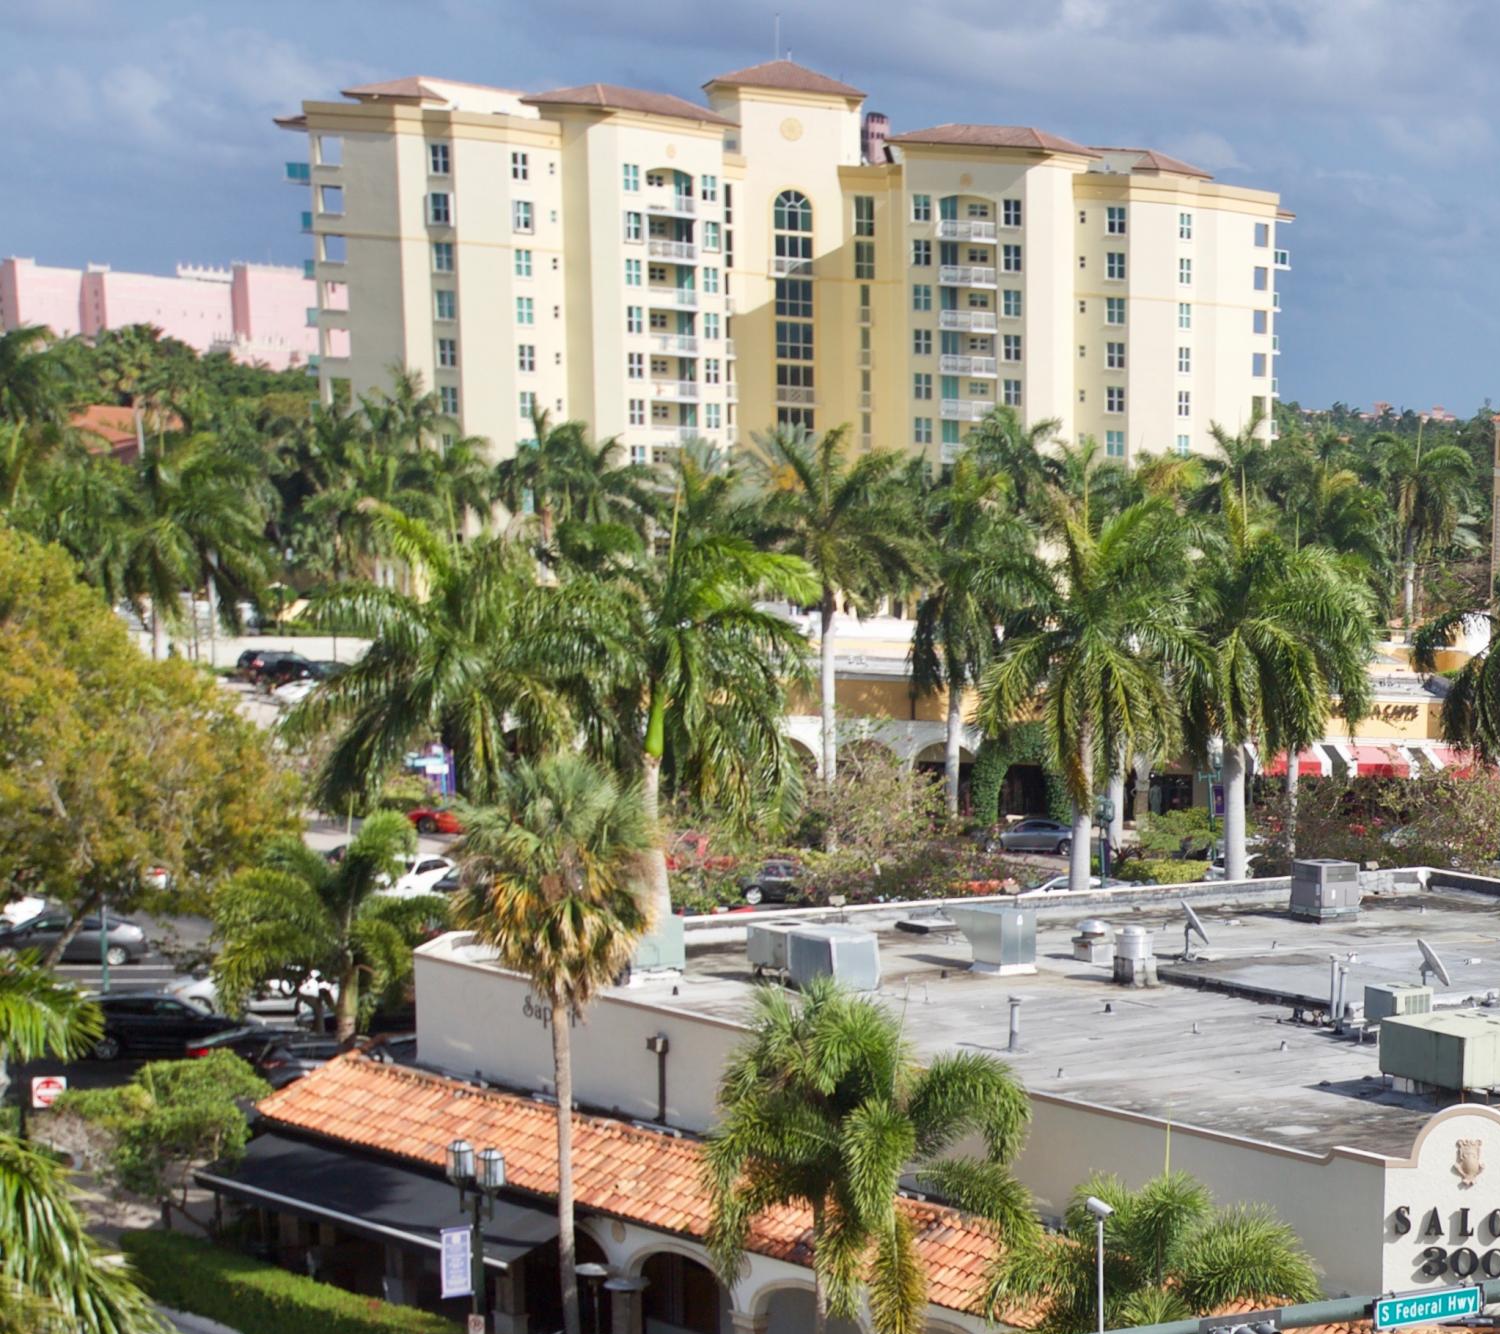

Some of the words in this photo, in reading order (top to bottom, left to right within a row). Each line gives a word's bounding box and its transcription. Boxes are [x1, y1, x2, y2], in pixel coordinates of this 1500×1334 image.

[1380, 1303, 1391, 1322] S
[1395, 1298, 1443, 1321] Federal
[1447, 1294, 1476, 1316] Hwy
